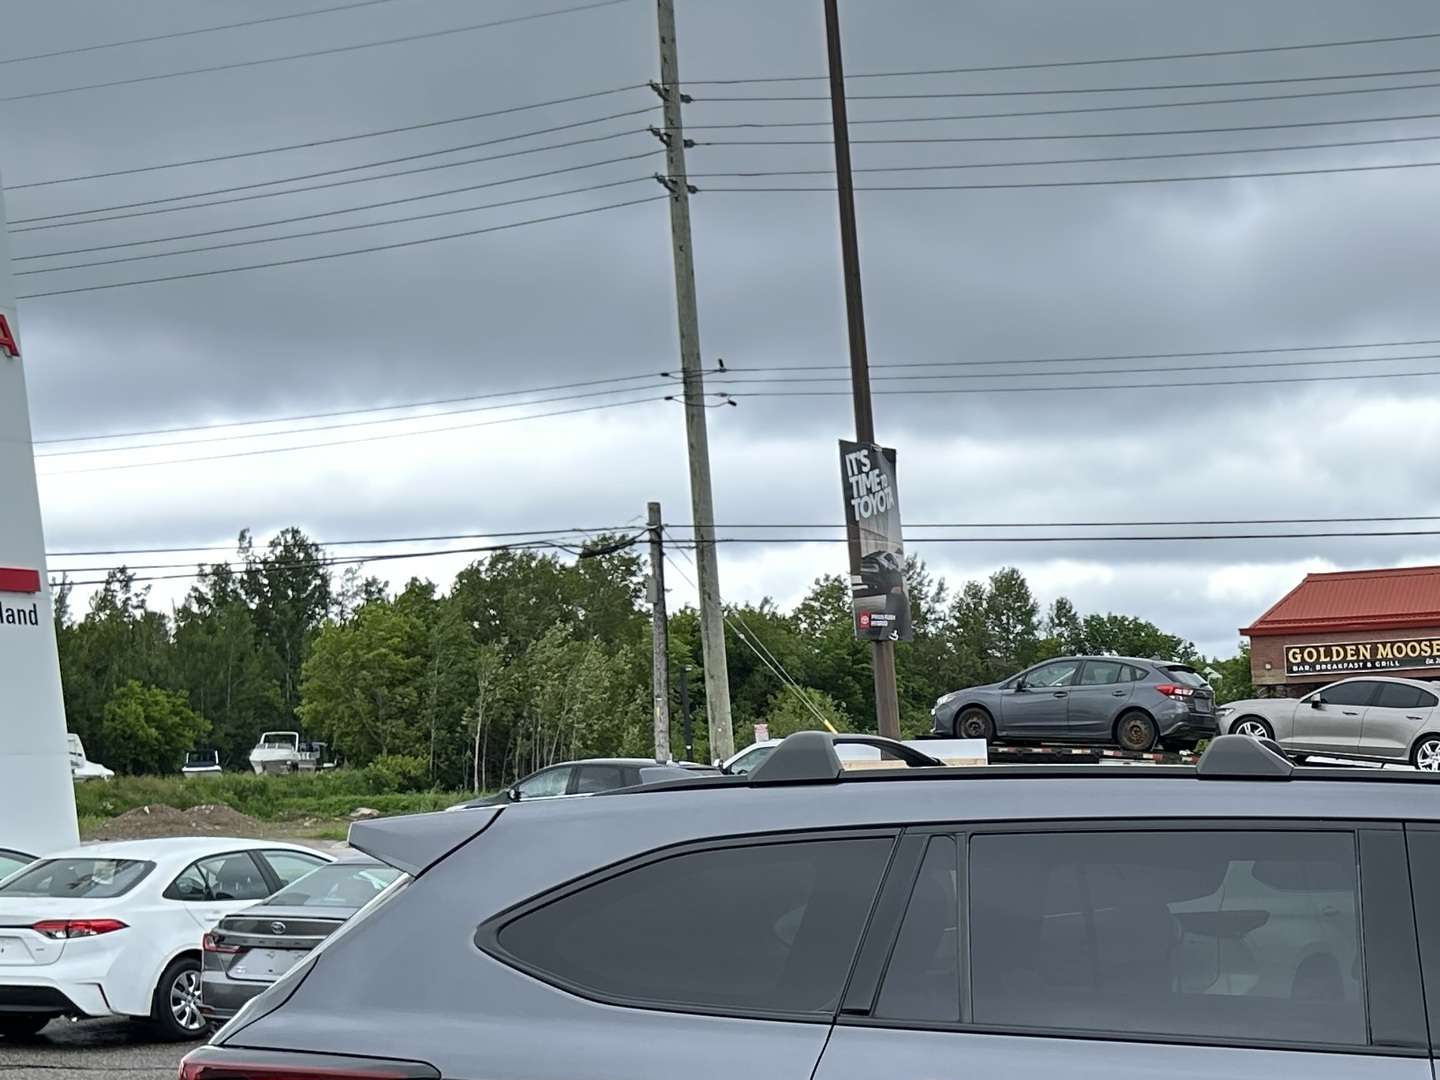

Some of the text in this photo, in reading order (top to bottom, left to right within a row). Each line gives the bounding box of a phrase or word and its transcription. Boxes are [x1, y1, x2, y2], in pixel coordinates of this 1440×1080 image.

[845, 449, 871, 477] IT'S
[849, 468, 881, 499] TIME
[851, 486, 895, 521] TOYOTA
[1288, 644, 1372, 663] GOLDEN
[1316, 662, 1363, 671] BREAKFAST
